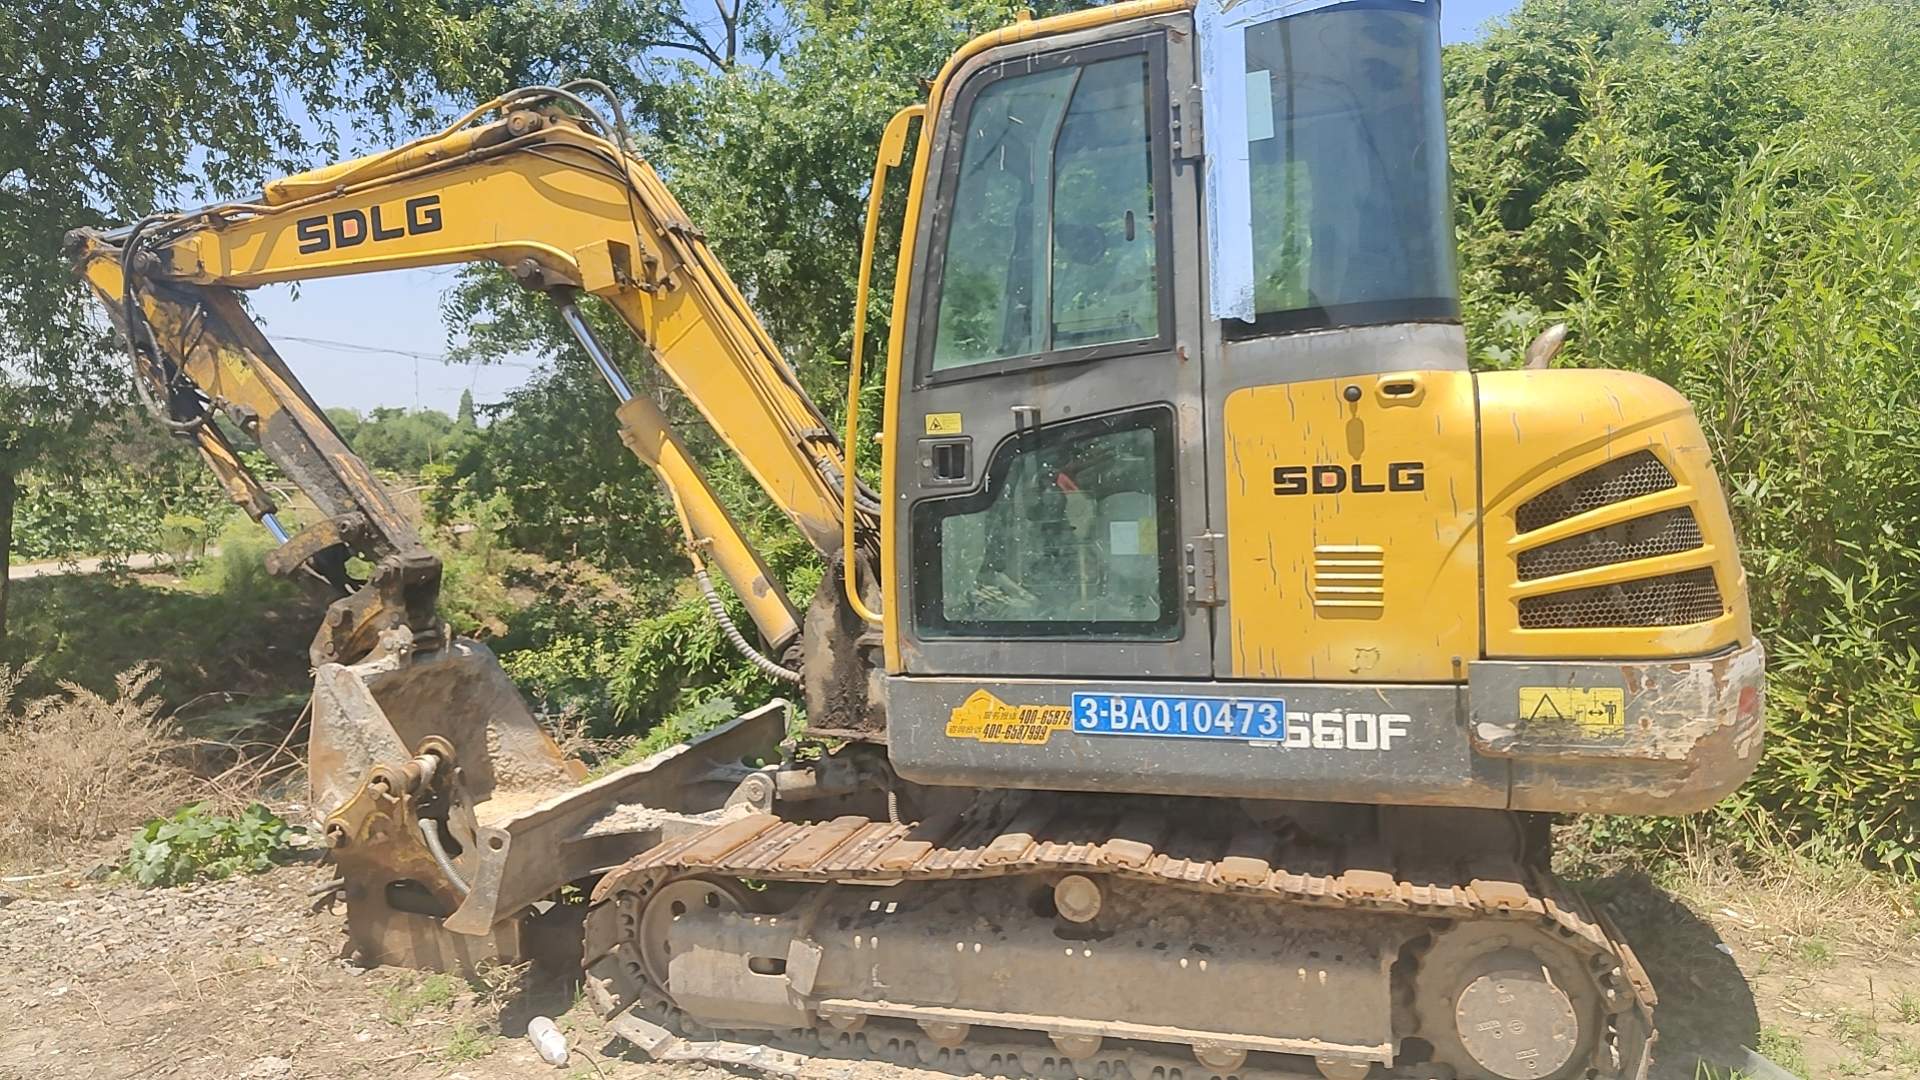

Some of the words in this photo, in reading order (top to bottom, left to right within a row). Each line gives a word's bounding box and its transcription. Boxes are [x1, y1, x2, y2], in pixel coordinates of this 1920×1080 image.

[297, 195, 442, 254] SDLG
[1273, 462, 1424, 495] SDLG
[1079, 697, 1279, 736] 3-BA010473
[1249, 712, 1412, 750] 660F
